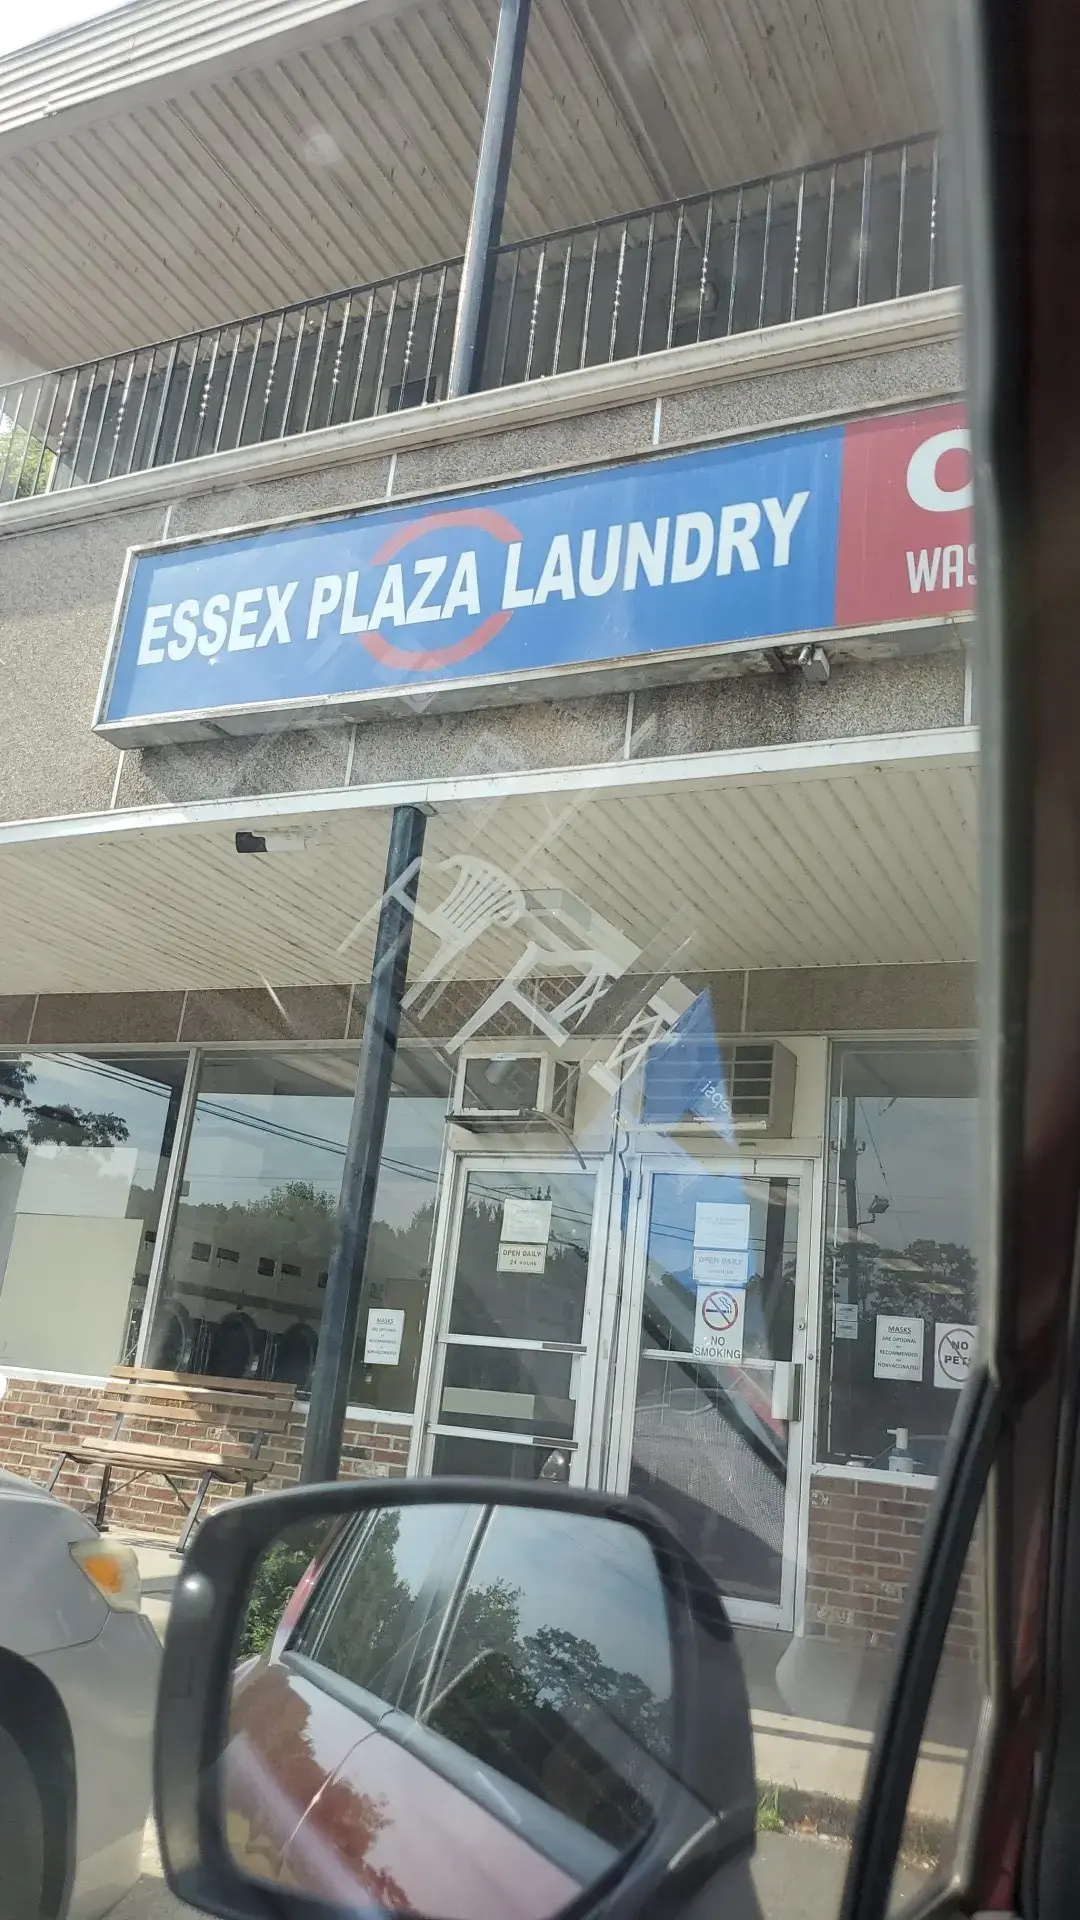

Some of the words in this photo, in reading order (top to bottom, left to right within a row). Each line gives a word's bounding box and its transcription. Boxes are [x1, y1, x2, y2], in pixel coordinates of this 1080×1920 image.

[137, 581, 299, 667] ESSEX
[305, 550, 481, 641] PLAZA
[501, 491, 810, 610] LAUNDRY
[503, 1249, 520, 1257] OPEN
[887, 1325, 912, 1334] MASKS
[711, 1336, 725, 1346] NO
[951, 1340, 969, 1350] NO
[694, 1346, 741, 1359] SMOKING
